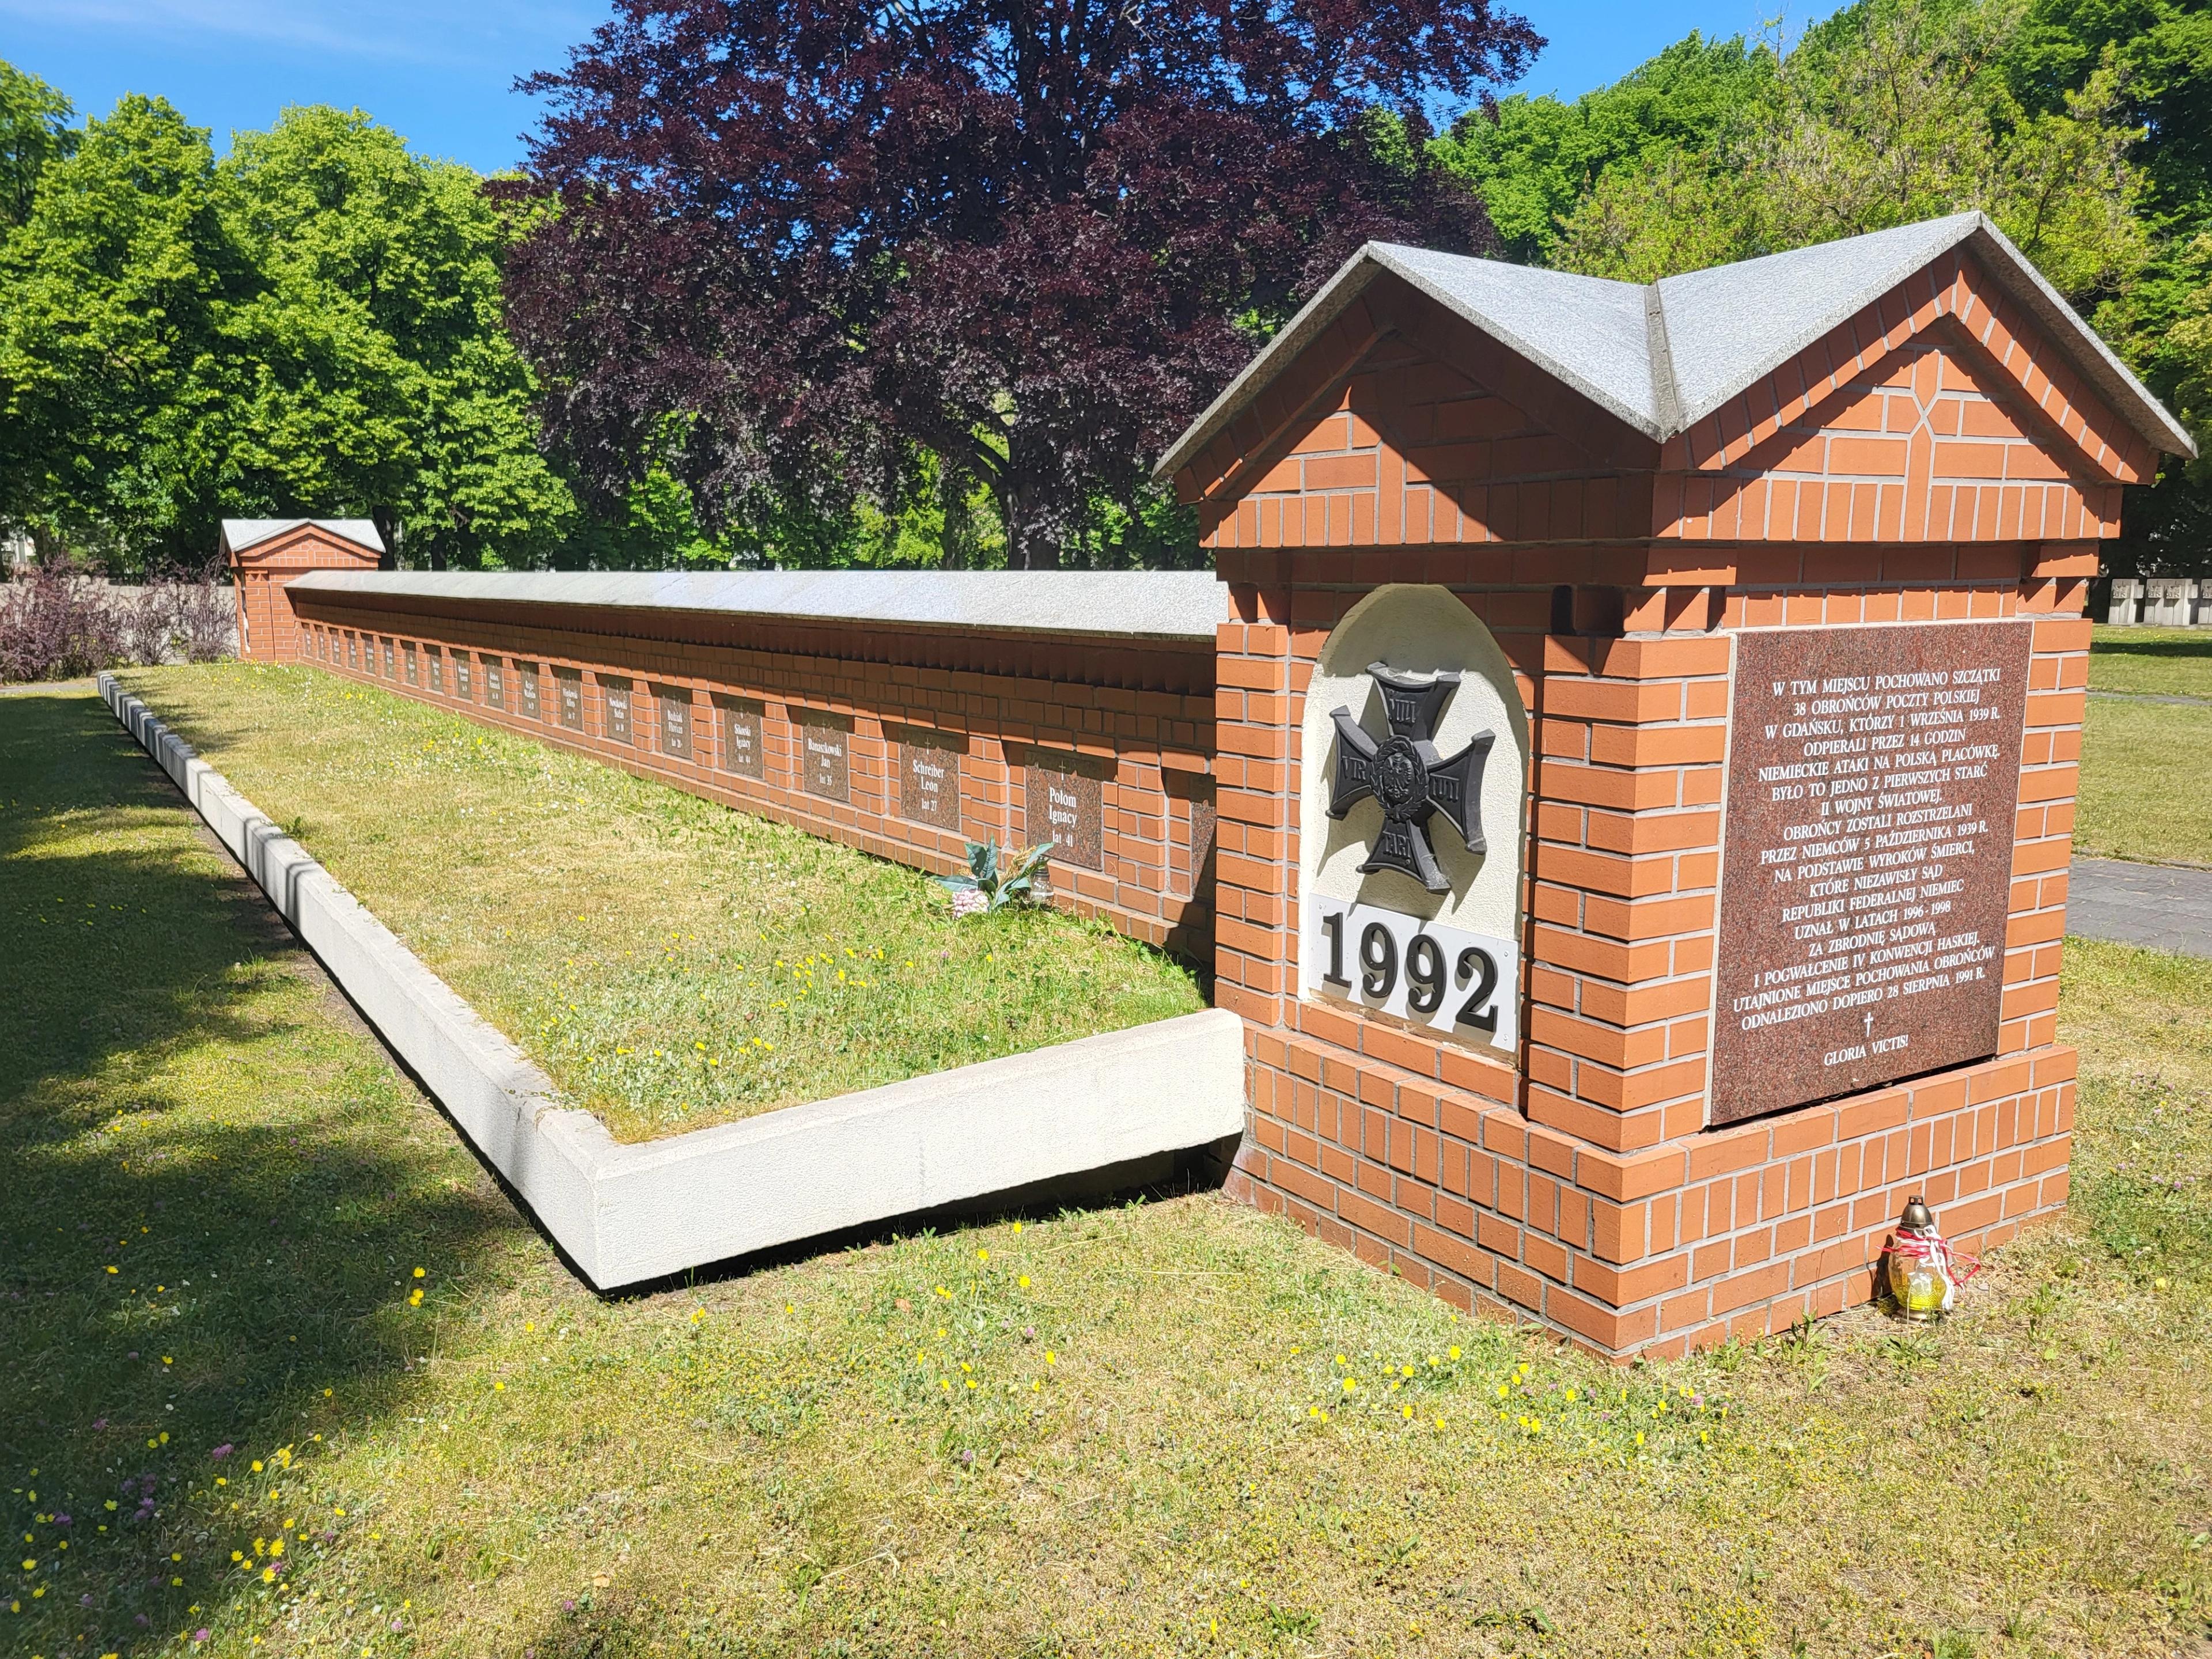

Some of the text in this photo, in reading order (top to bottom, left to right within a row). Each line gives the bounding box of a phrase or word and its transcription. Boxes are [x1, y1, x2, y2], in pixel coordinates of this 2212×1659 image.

[1772, 667, 2001, 696] W TYM MIEJSCU POCHOWANO SZCZĄTKI
[1793, 688, 1980, 716] 38 OBROŃCÓW POCZTY POLSKIEJ
[1764, 706, 2001, 740] W GDAŃSKU, KTÓRZY 1 WRZEŚNIA 1939 R.
[808, 737, 842, 757] Banaszkowski
[1803, 727, 1967, 756] ODPIERALI PRZEZ 14 GODZIN
[820, 754, 831, 768] Jan
[912, 759, 945, 779] Schreiber
[1758, 743, 2000, 782] NIEMIECKIE ATAKI NA POLSKĄ PLACÓWKĘ.
[827, 774, 832, 786] 35
[921, 775, 938, 793] Leon
[1771, 760, 1988, 801] BYŁO TO JEDNO Z PIERWSZYCH STARĆ
[922, 798, 937, 812] lat 27
[1049, 805, 1078, 828] Ignacy
[1820, 787, 1942, 816] II WOJNY ŚWIATOWEJ.
[1783, 802, 1973, 841] OBROŃCY ZOSTALI ROZSTRZELANI
[1052, 830, 1073, 847] lat 41
[1760, 819, 1988, 865] PRZEZ NIEMCÓW 5 PAŹDZIERNIKA 1939 R.
[1773, 839, 1975, 883] NA PODSTAWIE WYROKÓW ŚMIERCI,
[1808, 863, 1943, 898] KTÓRE NIEZAWISŁY SĄD
[1781, 878, 1964, 922] REPUBLIKI FEDERALNEJ NIEMIEC
[1793, 919, 1834, 940] UZNAŁ
[1838, 916, 1851, 932] W
[1854, 908, 1898, 930] LATACH
[1808, 921, 1936, 957] ZA ZBRODNIĘ SĄDOWĄ
[1323, 912, 1499, 1033] 1992
[1753, 930, 1980, 988] I POGWAŁCENIE IV KONWENCJI HASKIEJ.
[1732, 944, 1995, 1013] UTAJNIONE MIEJSCE POCHOWANIA OBROŃCÓW
[1741, 966, 1986, 1031] ODNALEZIONO DOPIERO 28 SIERPNIA 1991 R.
[1823, 1033, 1908, 1066] GLORIA VICTIS!
